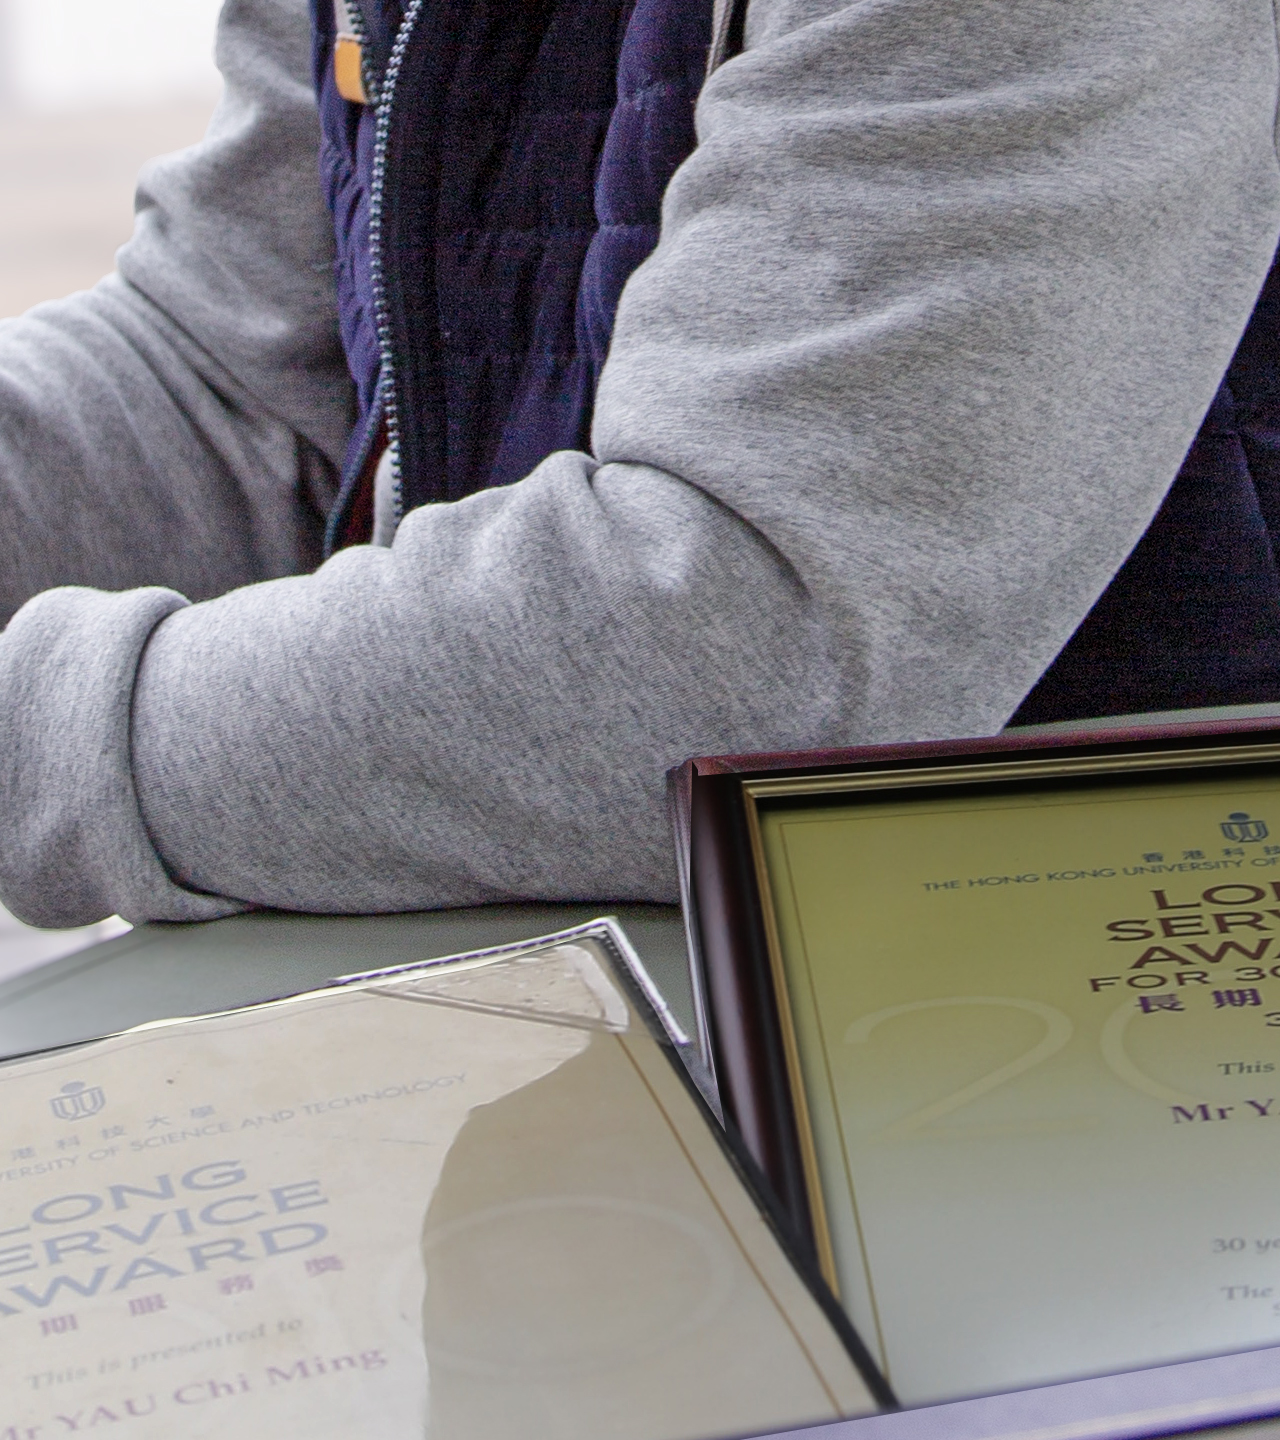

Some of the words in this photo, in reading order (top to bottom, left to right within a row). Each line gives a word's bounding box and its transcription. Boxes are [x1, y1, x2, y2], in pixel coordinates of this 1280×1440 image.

[922, 878, 961, 893] THE
[967, 872, 1040, 888] HONG
[1045, 867, 1117, 882] KONG
[1121, 857, 1243, 878] UNIVERSITY
[1086, 970, 1213, 994] FOR
[1216, 1060, 1276, 1078] This
[87, 1143, 119, 1163] OF
[130, 1123, 235, 1153] SCIENCE
[240, 1108, 296, 1130] AND
[303, 1071, 469, 1116] TECHNOLOGY
[1168, 1101, 1236, 1126] Mr
[1211, 1235, 1248, 1256] 30
[1219, 1282, 1273, 1302] The
[23, 1367, 89, 1392] This
[98, 1357, 123, 1376] is
[129, 1328, 268, 1372] presented
[274, 1317, 305, 1339] to
[53, 1393, 160, 1434] YAU
[172, 1372, 253, 1407] Chi
[267, 1347, 390, 1388] Ming
